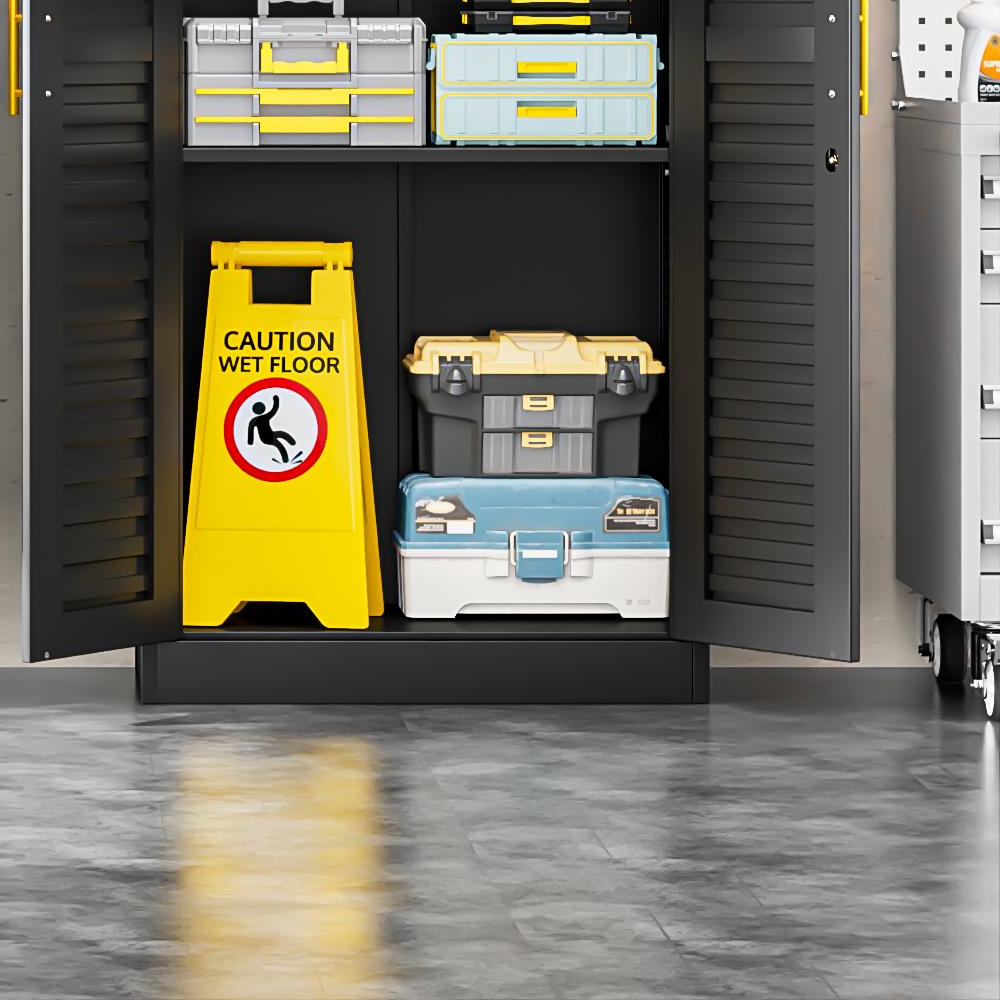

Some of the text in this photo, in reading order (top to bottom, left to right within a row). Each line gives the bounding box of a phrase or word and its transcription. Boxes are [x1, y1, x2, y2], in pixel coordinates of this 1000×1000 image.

[223, 331, 335, 352] CAUTION
[218, 356, 340, 374] WET FLOOR
